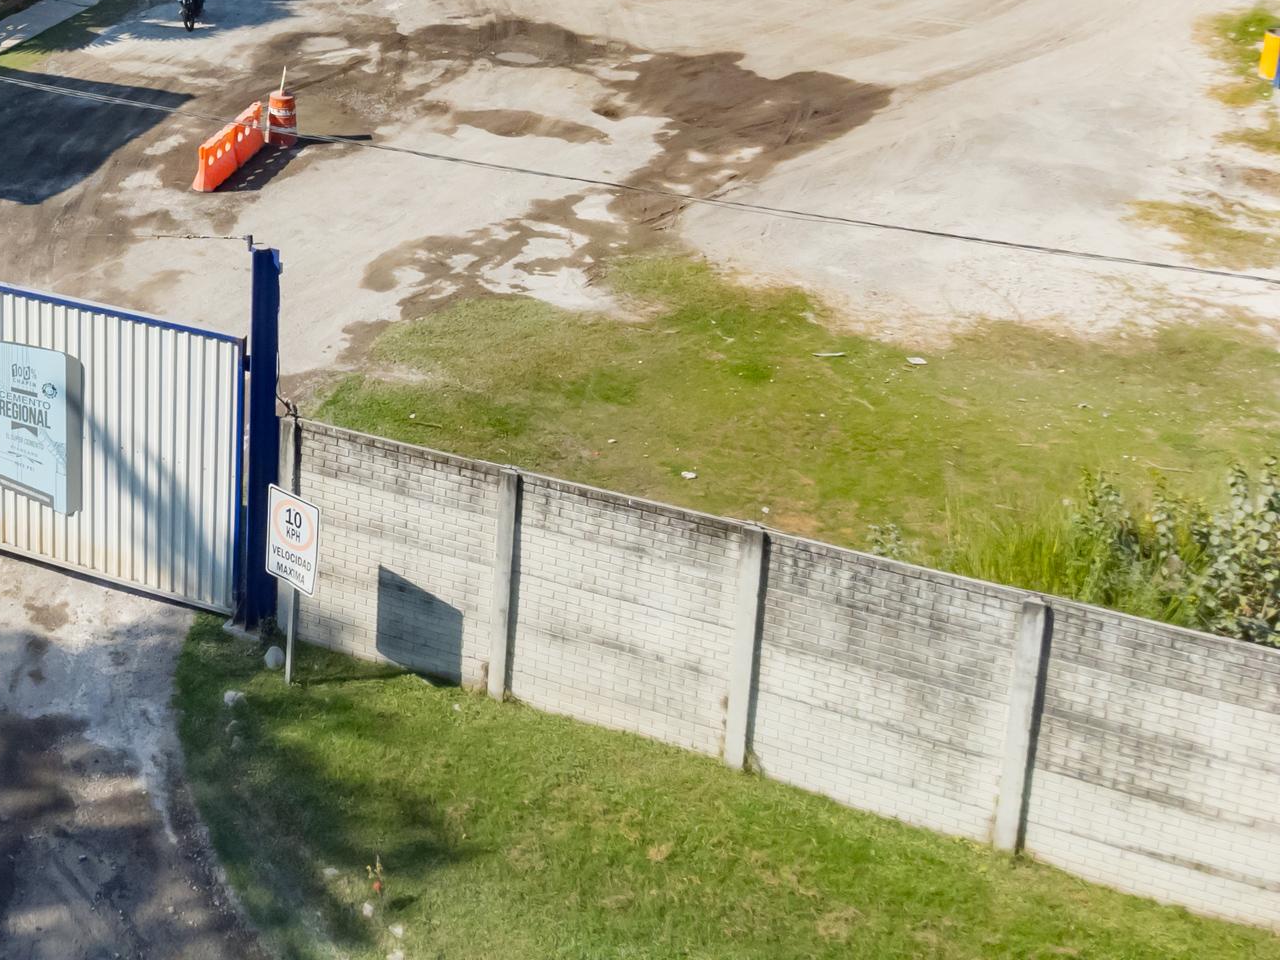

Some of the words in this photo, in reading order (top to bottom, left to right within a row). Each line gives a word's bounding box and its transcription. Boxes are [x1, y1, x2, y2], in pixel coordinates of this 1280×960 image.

[0, 390, 51, 410] CEMENTO
[0, 399, 52, 429] REGIONAL
[285, 507, 302, 529] 10
[285, 525, 301, 543] KPH
[272, 544, 312, 572] VELOCIDAD
[276, 561, 305, 585] MAXIMA
